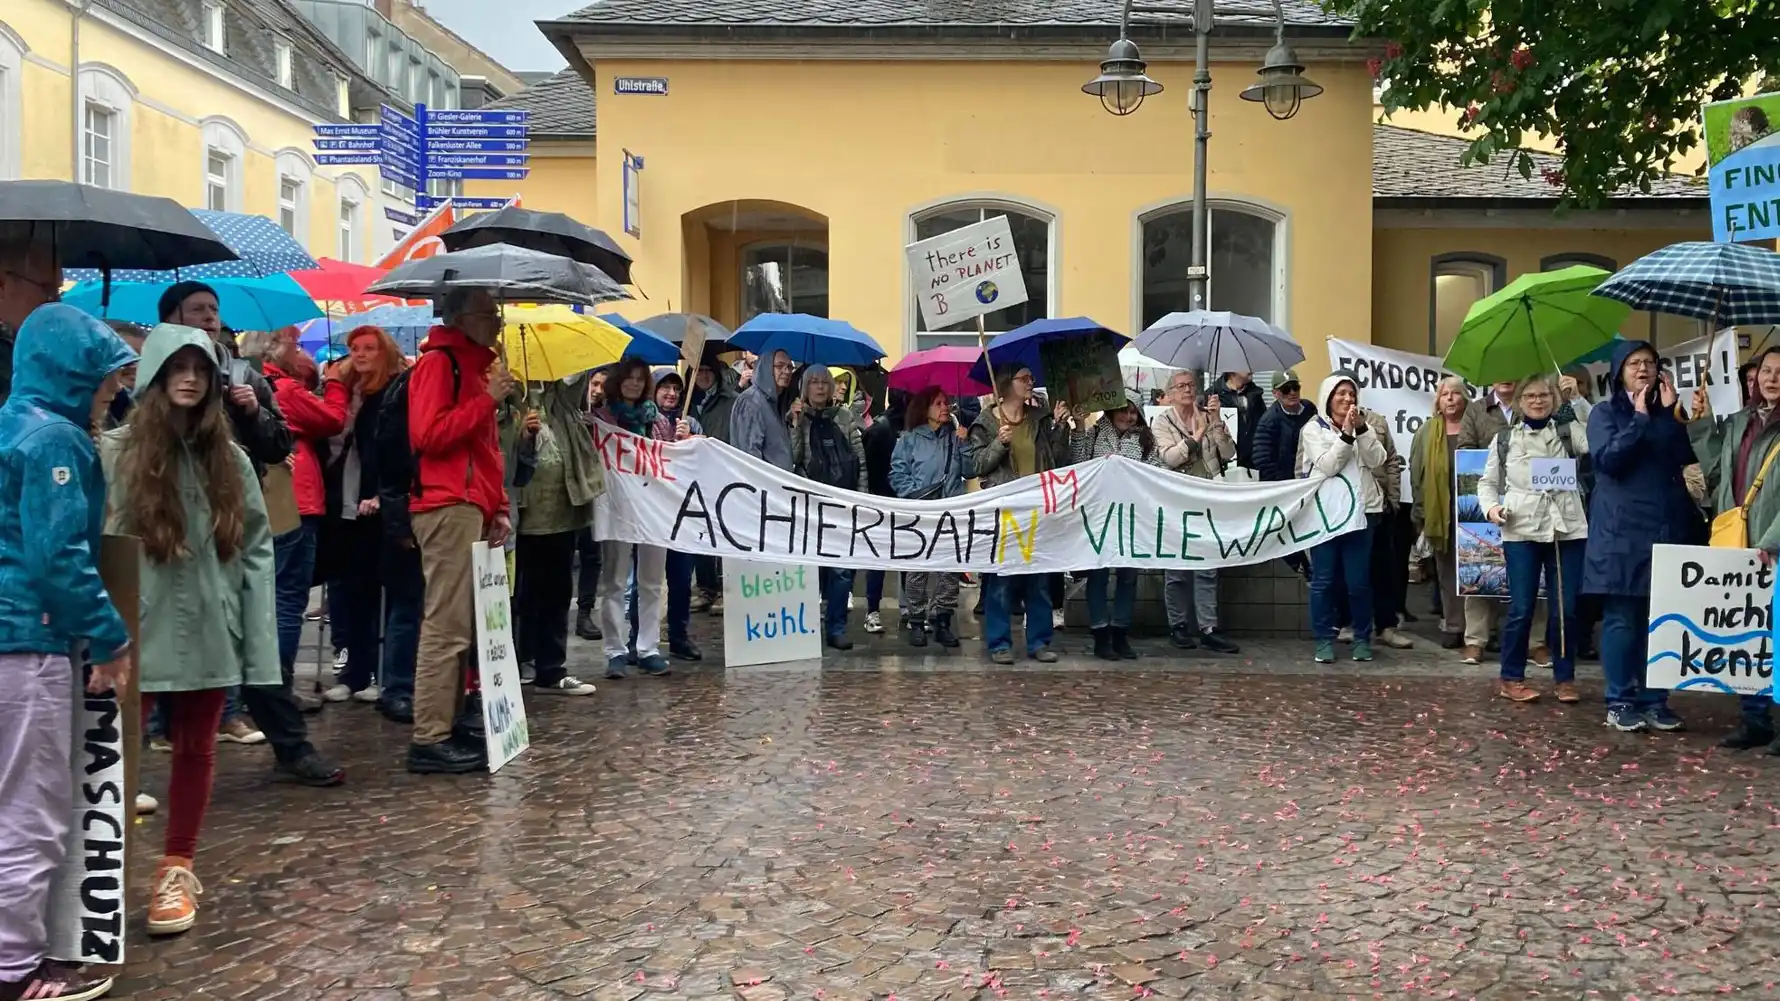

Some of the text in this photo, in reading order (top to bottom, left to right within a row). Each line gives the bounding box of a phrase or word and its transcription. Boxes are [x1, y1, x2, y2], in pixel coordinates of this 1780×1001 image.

[619, 79, 663, 91] Uhlstraße
[437, 112, 482, 121] Giesler-Galerie
[348, 141, 375, 149] Bahnhof
[438, 156, 487, 165] Franziskanerhof
[428, 171, 462, 179] Zoom-Kino
[1725, 163, 1780, 189] FIN
[925, 236, 1000, 272] there is
[931, 253, 1012, 289] NO PLANET
[930, 292, 949, 315] B
[1093, 390, 1117, 402] STOP
[1395, 409, 1432, 434] fo
[593, 422, 676, 481] KEINE
[1040, 469, 1078, 514] IM
[1532, 475, 1576, 485] BOVIVO
[670, 472, 1355, 566] ACHTERBAHN VILLEWALD
[741, 565, 806, 598] bleibt
[1681, 559, 1773, 589] Damit
[746, 602, 815, 641] kühl.
